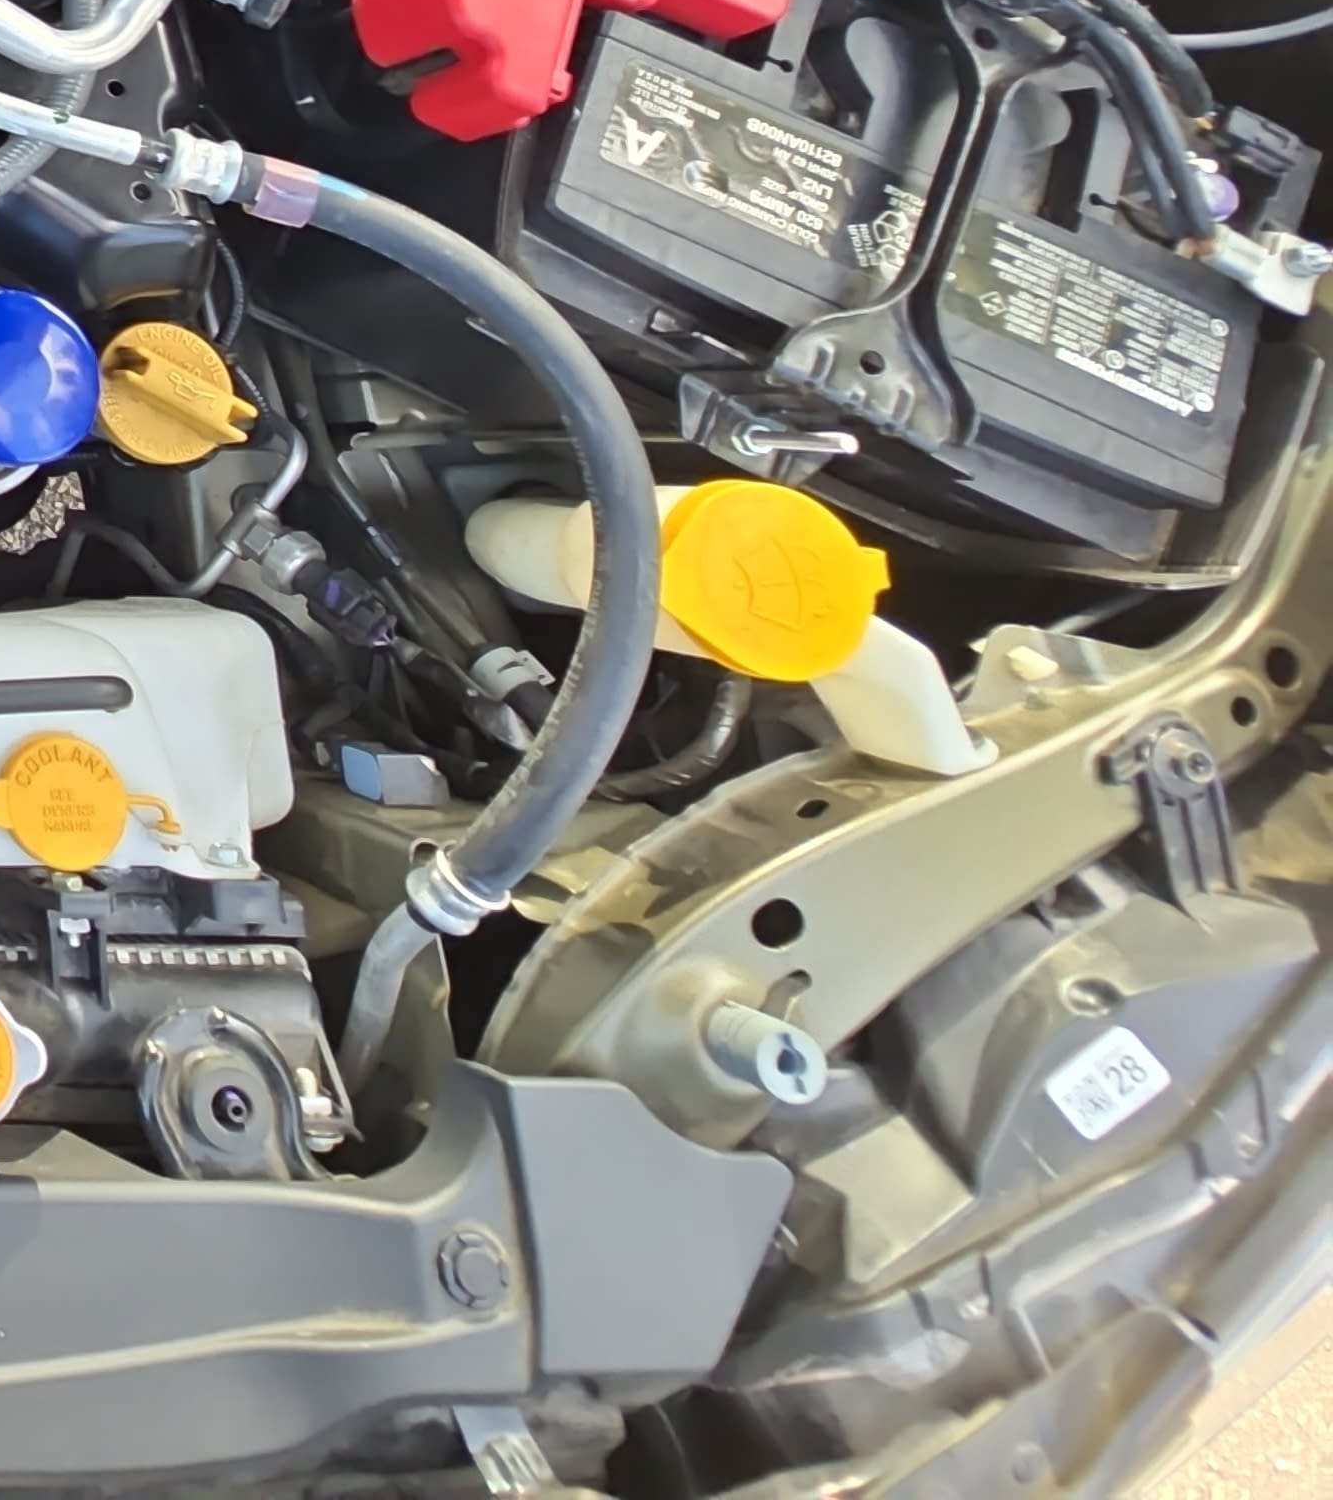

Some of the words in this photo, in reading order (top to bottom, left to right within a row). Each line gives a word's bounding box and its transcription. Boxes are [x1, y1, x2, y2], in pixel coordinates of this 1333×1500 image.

[623, 116, 667, 166] A
[746, 117, 843, 167] 82110AN00B
[761, 177, 787, 194] SIZE
[787, 189, 829, 212] GROUP
[801, 176, 833, 199] LN2
[728, 197, 786, 229] CRANKING
[750, 188, 796, 218] AMPS
[788, 223, 819, 244] COLD
[797, 211, 823, 230] 620
[136, 327, 205, 354] ENGINE
[203, 354, 225, 382] OIL
[15, 744, 113, 788] COOLANT
[1104, 1054, 1148, 1096] 28
